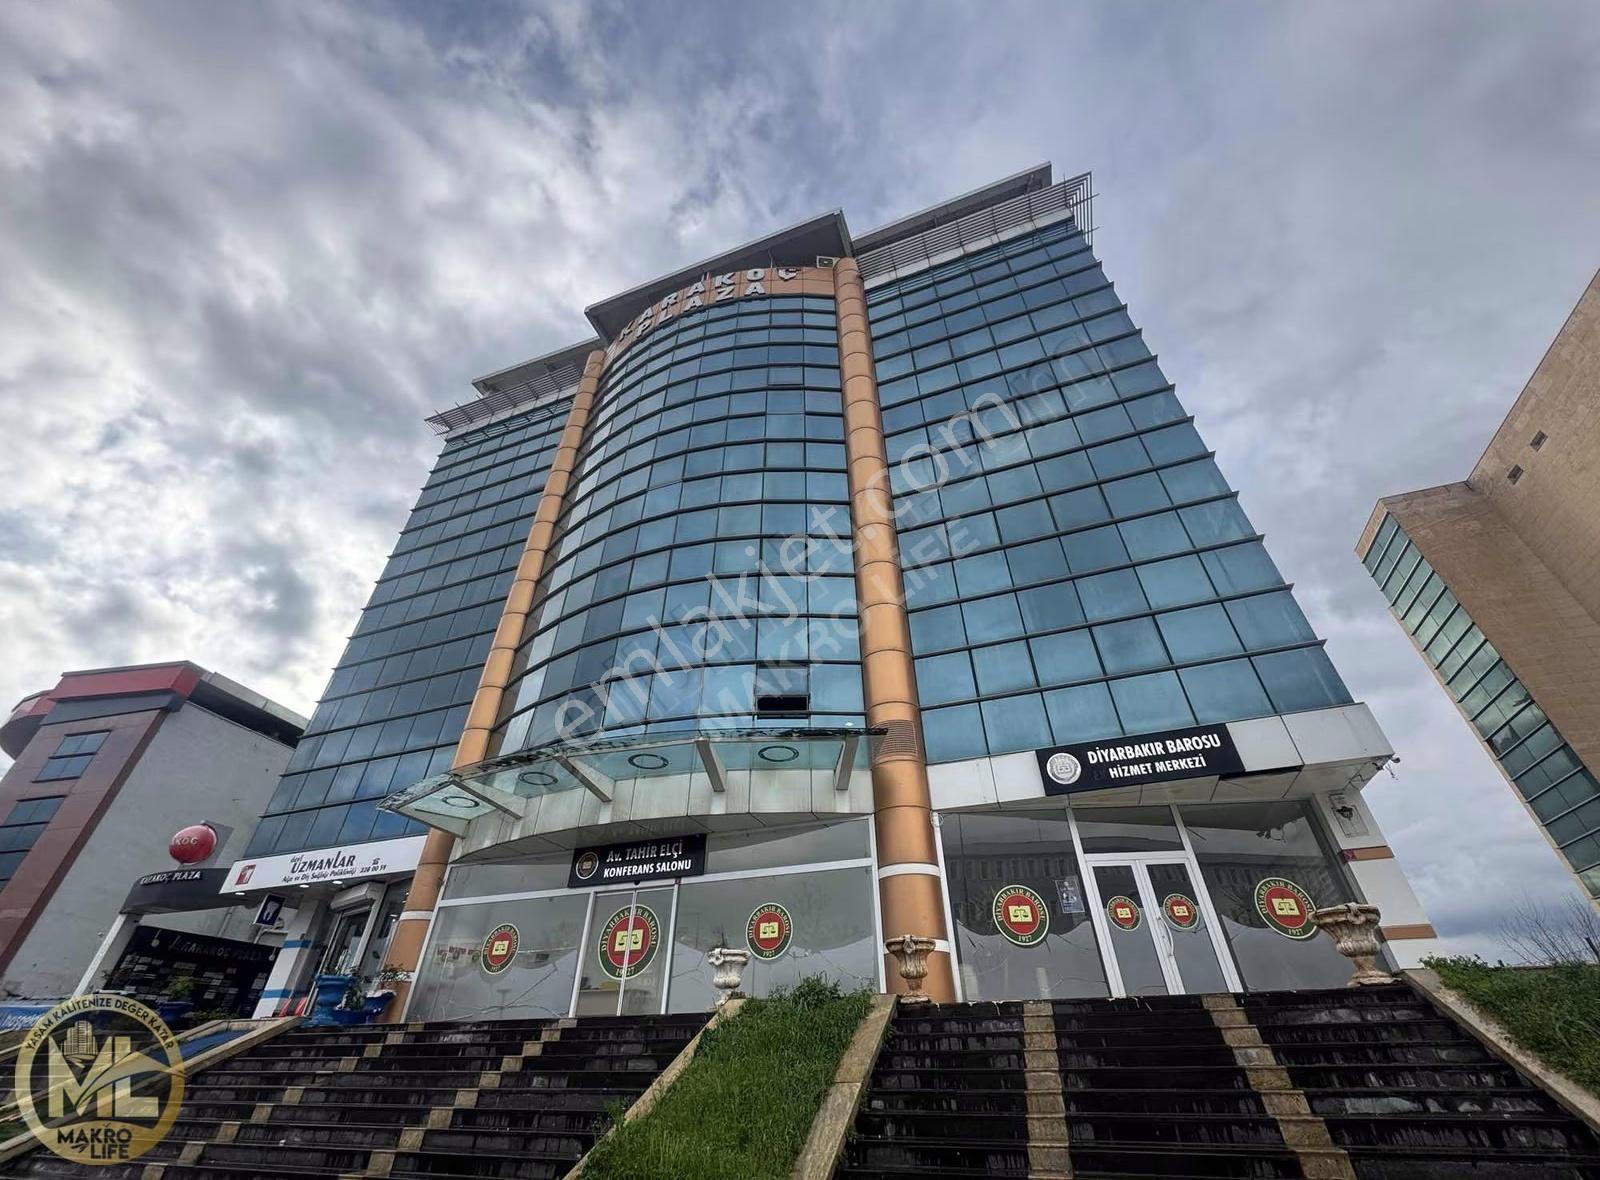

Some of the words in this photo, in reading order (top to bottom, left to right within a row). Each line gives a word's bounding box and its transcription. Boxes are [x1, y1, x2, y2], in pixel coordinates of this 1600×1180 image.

[636, 281, 767, 338] PLAZA
[1086, 741, 1165, 765] DİYARBAKIR
[1167, 733, 1222, 755] BAROSU
[1108, 762, 1153, 779] HİZMET
[1155, 753, 1207, 774] MERKEZİ
[290, 850, 356, 874] UZMANLAR
[606, 850, 622, 863] Av.
[625, 844, 657, 861] TAHİR
[660, 839, 683, 859] ELÇİ
[172, 870, 201, 881] PLAZA
[603, 862, 654, 879] KONFERANS
[655, 859, 692, 873] SALONU
